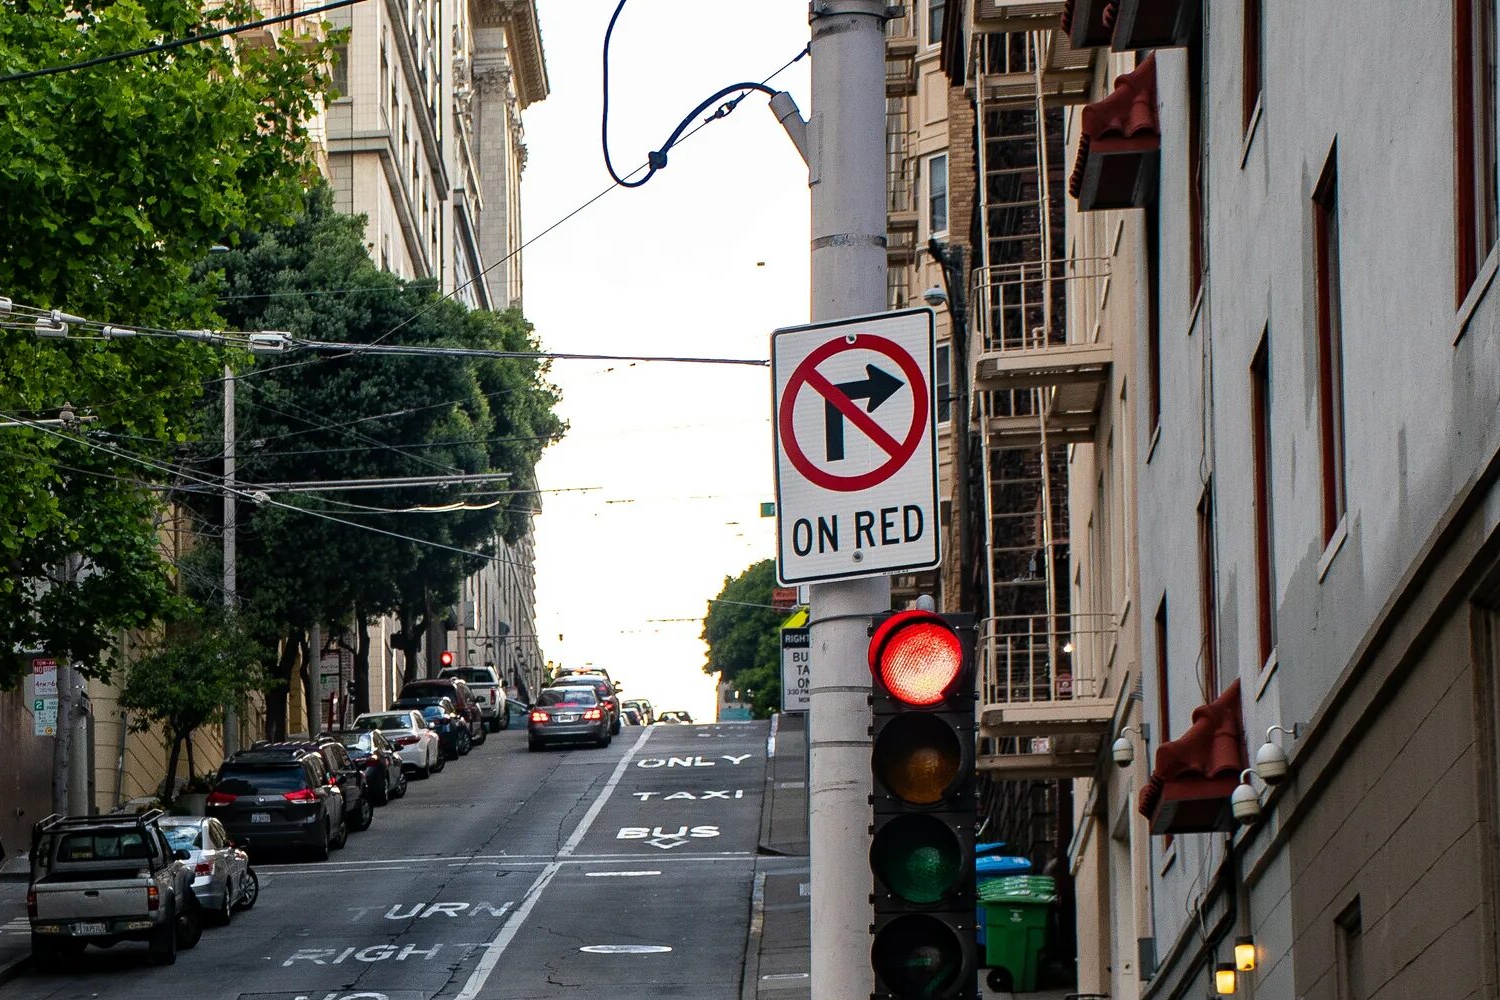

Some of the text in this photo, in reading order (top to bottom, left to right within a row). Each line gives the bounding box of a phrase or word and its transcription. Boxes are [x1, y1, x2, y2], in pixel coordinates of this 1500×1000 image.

[793, 505, 924, 557] ON RED
[637, 753, 752, 768] ONLY
[633, 789, 744, 801] TAXI
[616, 825, 721, 839] BUS
[348, 900, 515, 922] TURN
[281, 941, 494, 967] RIGHT
